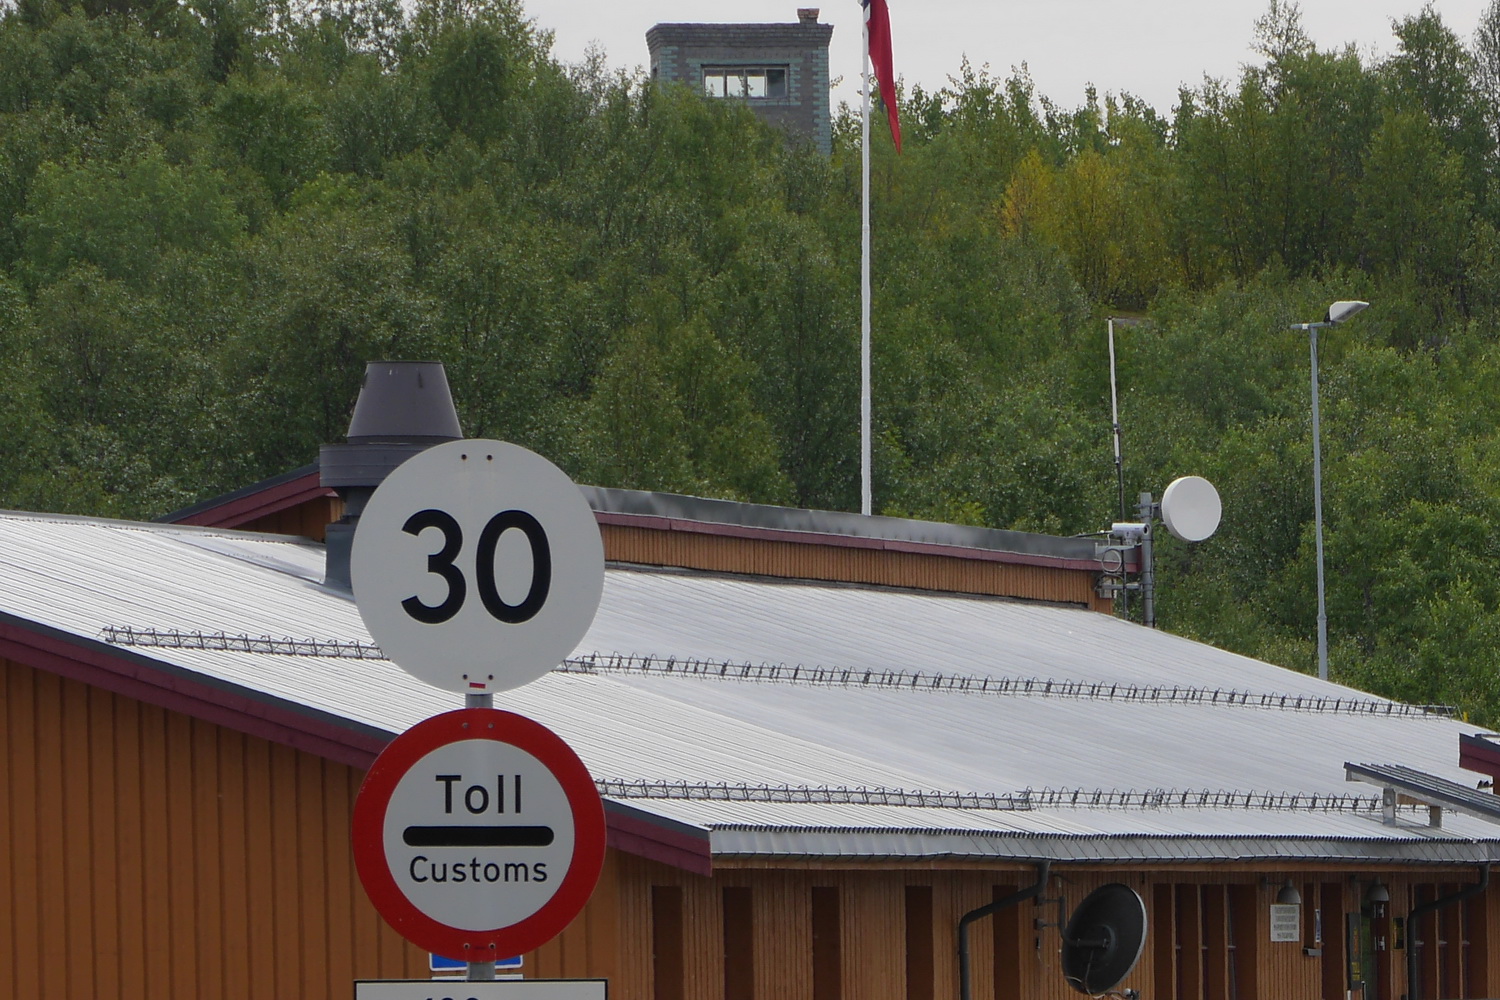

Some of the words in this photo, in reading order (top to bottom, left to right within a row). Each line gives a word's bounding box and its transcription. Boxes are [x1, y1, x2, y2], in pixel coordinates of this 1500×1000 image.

[400, 509, 552, 625] 30
[435, 774, 522, 815] Toll
[409, 855, 549, 883] Customs
